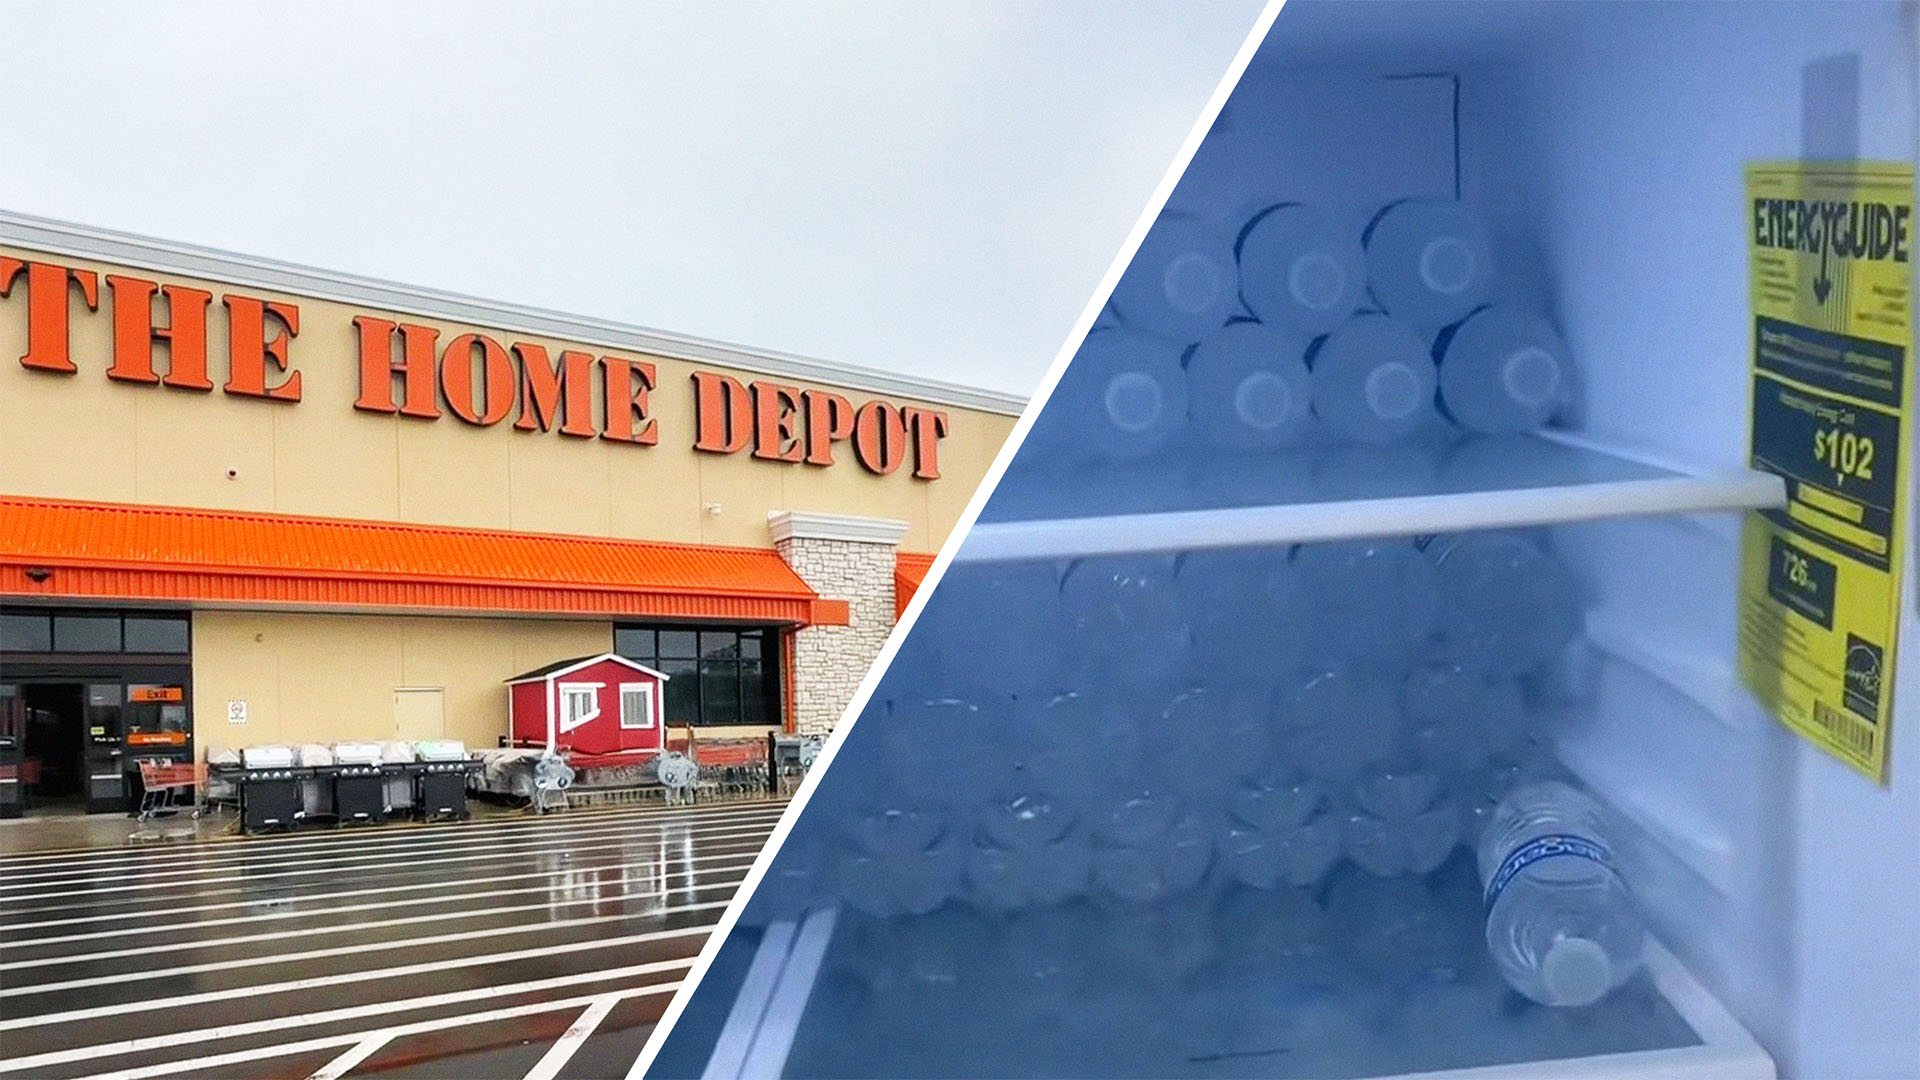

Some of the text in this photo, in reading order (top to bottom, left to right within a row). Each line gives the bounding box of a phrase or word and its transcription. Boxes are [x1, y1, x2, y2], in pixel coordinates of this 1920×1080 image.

[1754, 198, 1909, 262] ENERGYGUIDE
[0, 256, 949, 480] THE HOME DEPOT
[1814, 428, 1874, 480] $102
[147, 690, 168, 699] Exit
